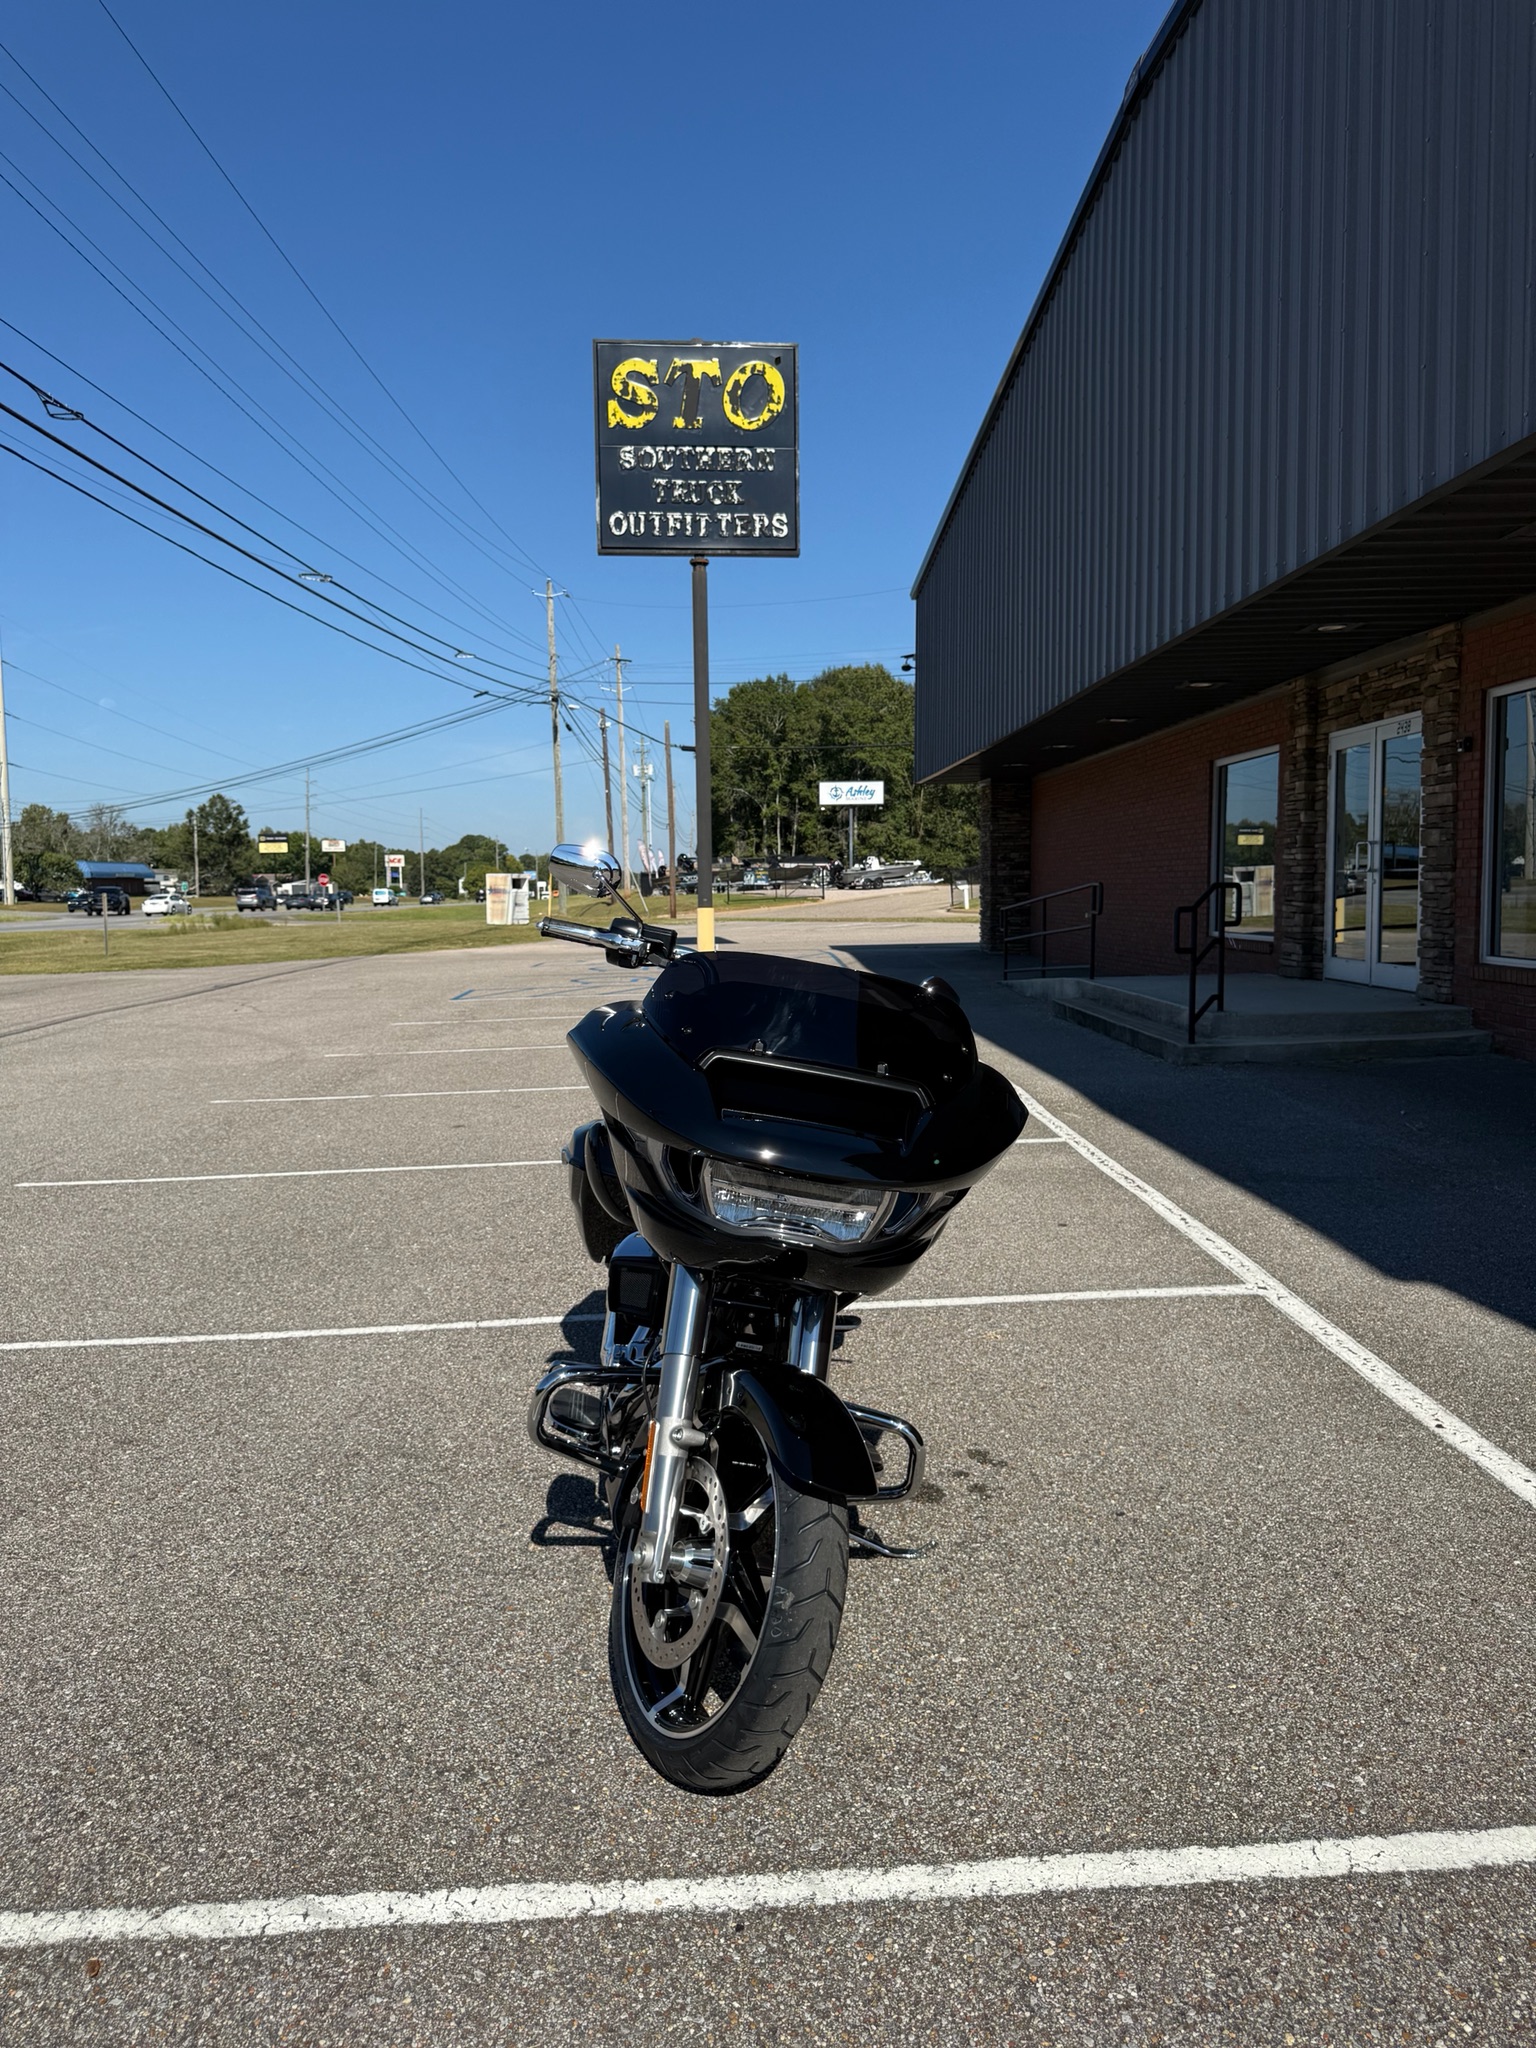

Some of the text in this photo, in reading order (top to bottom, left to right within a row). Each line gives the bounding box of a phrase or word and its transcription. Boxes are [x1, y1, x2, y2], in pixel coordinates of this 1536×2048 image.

[607, 358, 785, 431] STO
[619, 446, 775, 471] SOUTHERN
[652, 478, 745, 504] TRUCK
[608, 510, 789, 538] OUTFITTERS
[845, 785, 876, 800] Ashley
